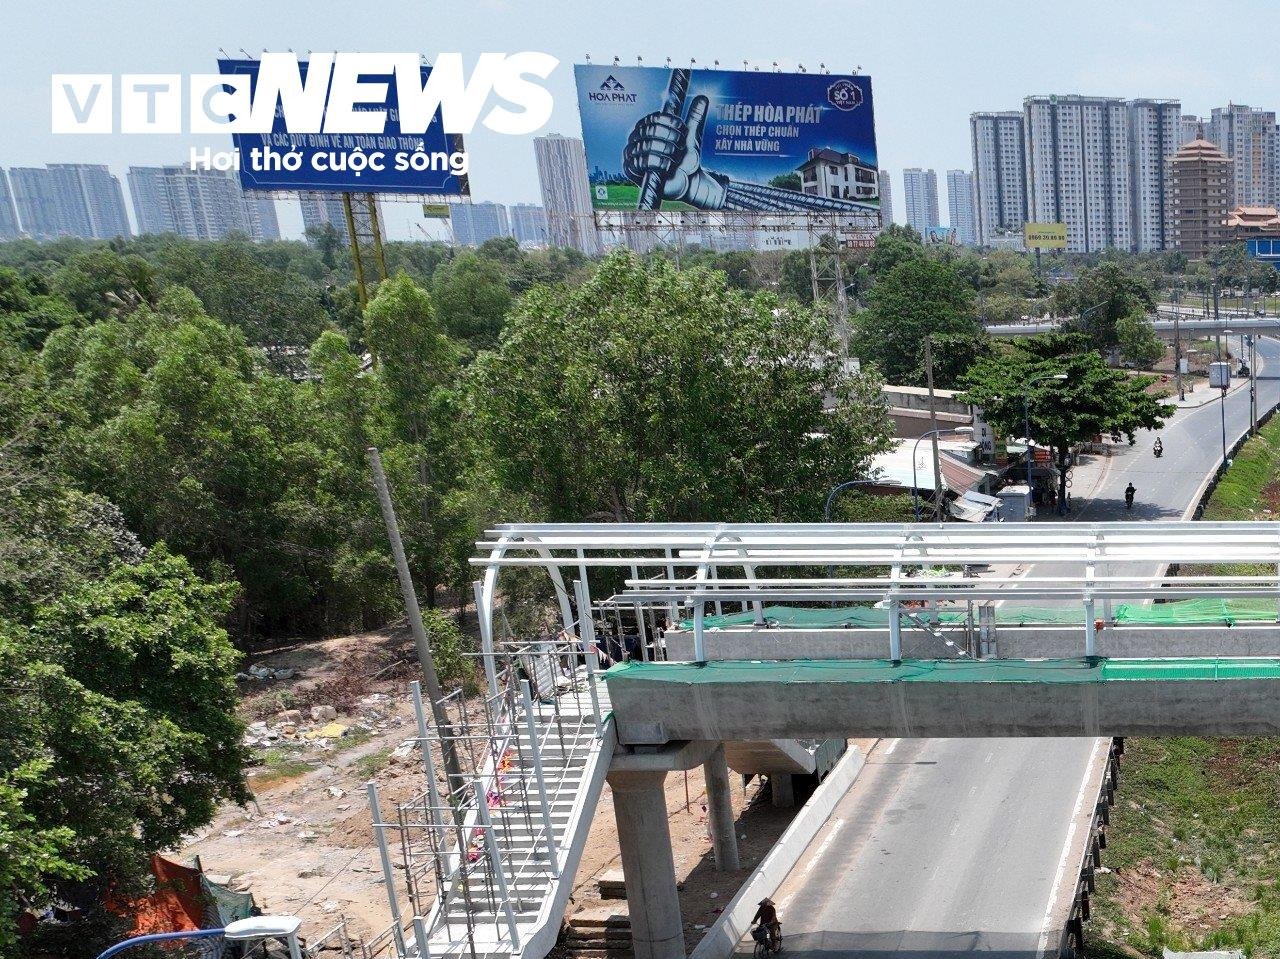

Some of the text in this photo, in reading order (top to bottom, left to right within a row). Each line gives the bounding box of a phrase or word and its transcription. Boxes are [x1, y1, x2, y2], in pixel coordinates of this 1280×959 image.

[850, 91, 856, 101] 1
[715, 101, 821, 124] THÉP HÒA PHÁT
[715, 124, 741, 139] CHỌN
[744, 124, 767, 137] THÉP
[343, 135, 355, 149] AN
[378, 136, 397, 150] GIAO
[715, 137, 733, 151] XÂY
[734, 138, 753, 151] NHÀ
